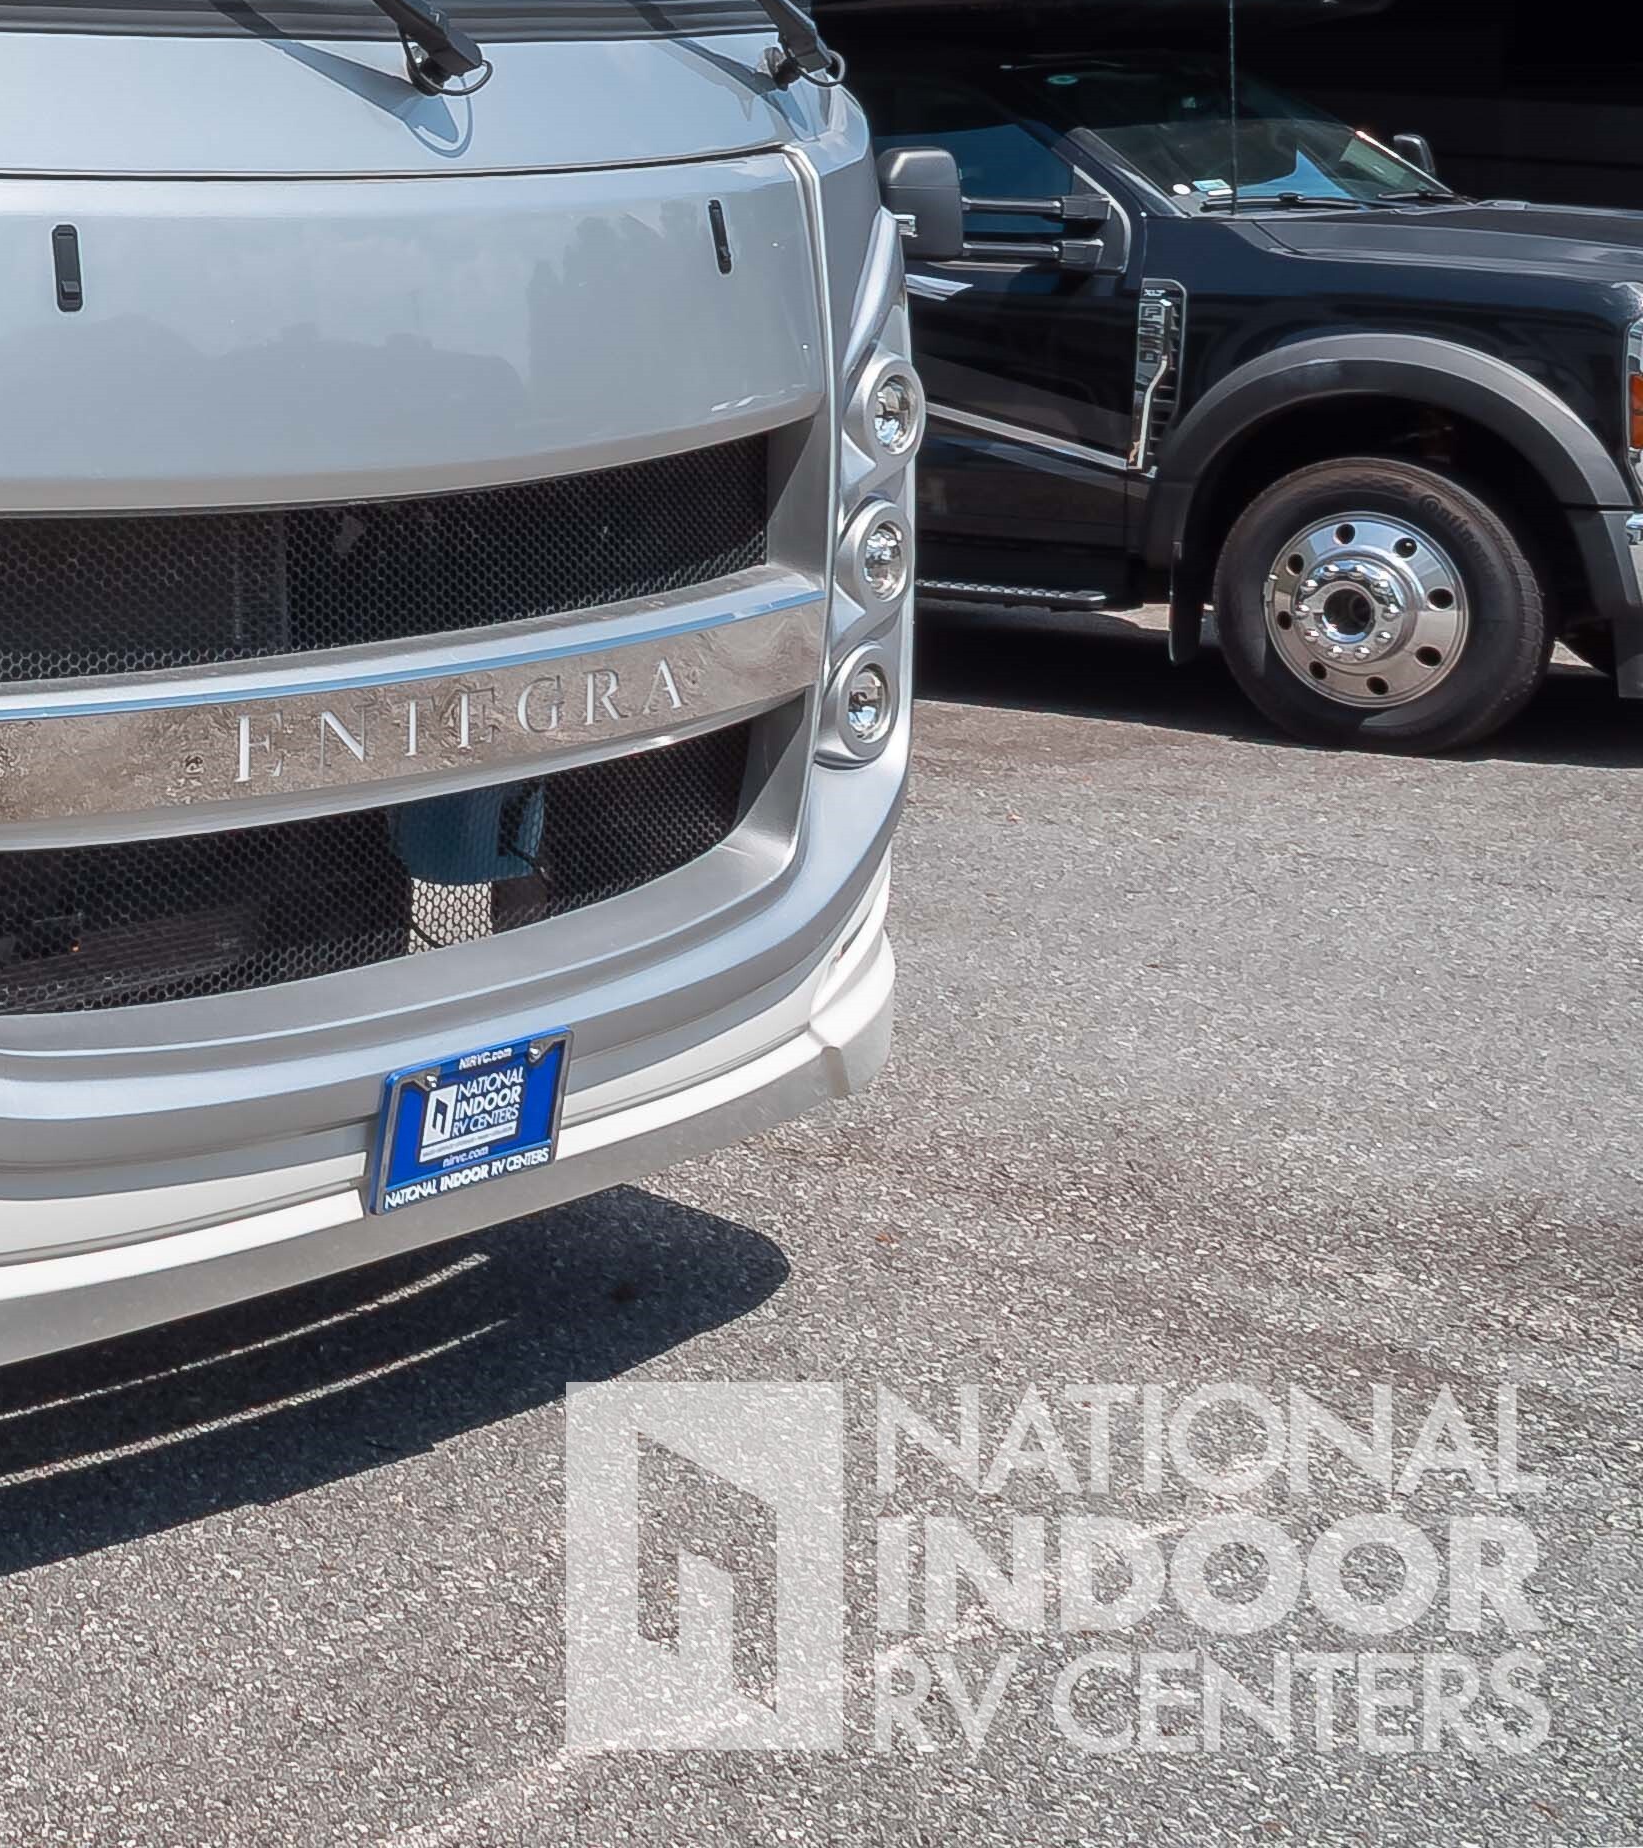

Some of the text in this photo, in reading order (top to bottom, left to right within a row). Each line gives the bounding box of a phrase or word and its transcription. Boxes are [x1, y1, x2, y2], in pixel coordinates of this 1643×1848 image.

[234, 656, 684, 784] ENTEGRA
[457, 1066, 524, 1100] NATIONAL
[454, 1086, 523, 1121] INDOOR
[451, 1104, 520, 1138] RV CENTERS
[442, 1145, 489, 1168] nirvc.com
[385, 1147, 550, 1209] NATIONAL INDOOR RV CENTERS
